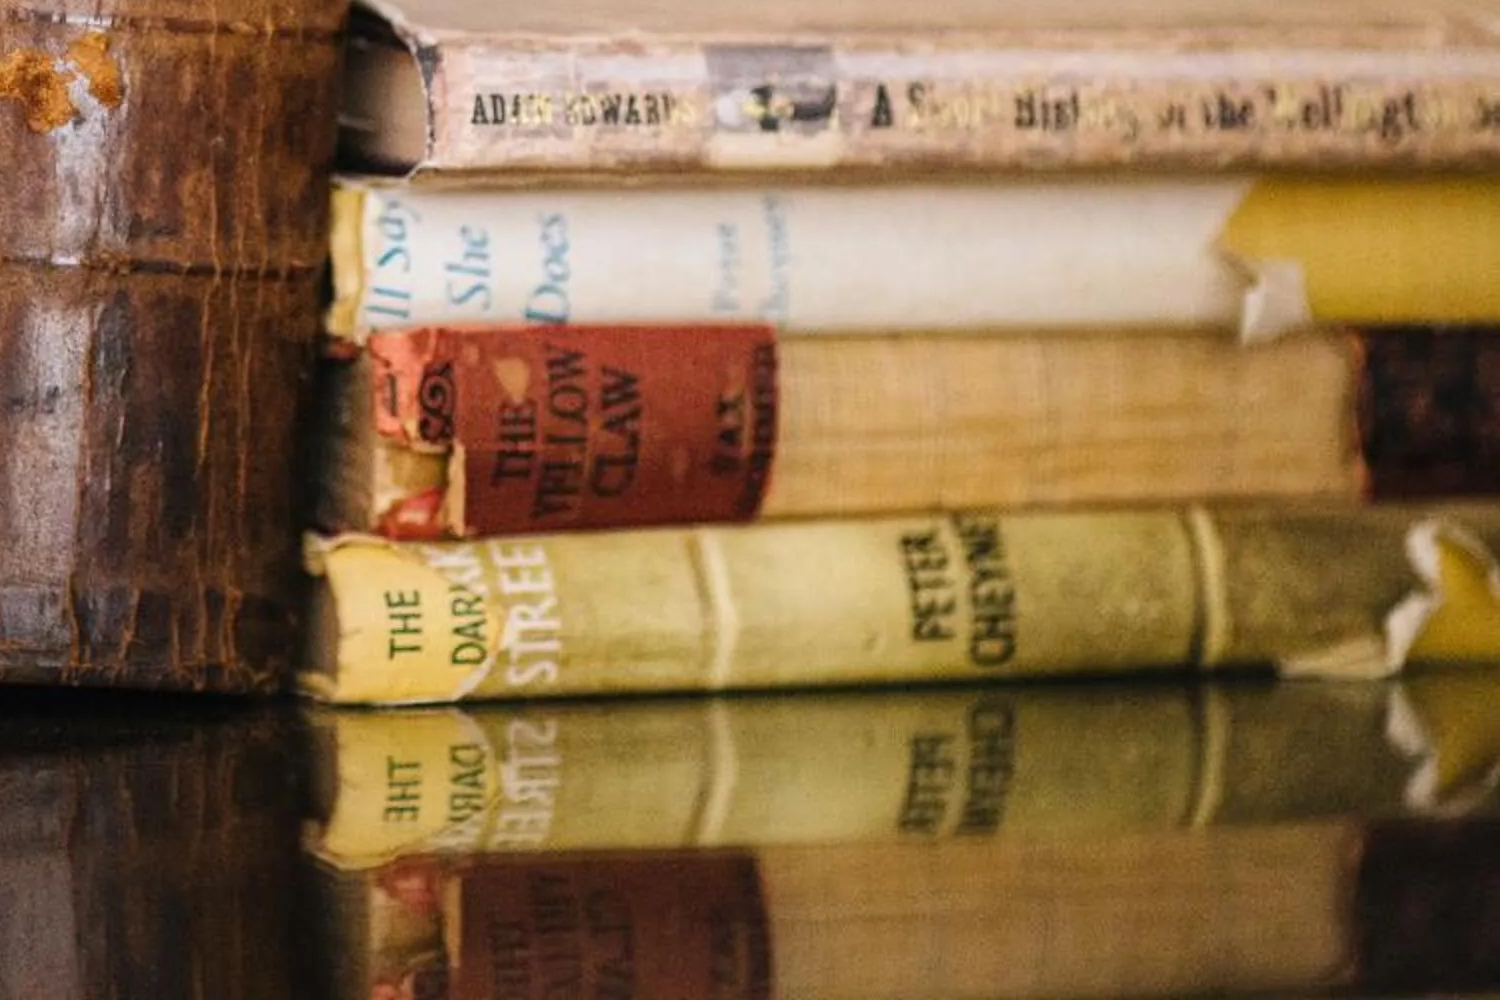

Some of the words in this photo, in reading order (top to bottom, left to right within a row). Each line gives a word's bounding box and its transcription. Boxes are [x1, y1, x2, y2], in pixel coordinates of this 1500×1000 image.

[443, 225, 493, 312] She
[522, 211, 571, 324] Does
[490, 396, 536, 488] THE
[528, 342, 588, 520] YELLOW
[588, 365, 642, 499] CLAW
[384, 590, 423, 661] THE
[489, 542, 563, 687] STREE
[900, 531, 958, 642] PETER
